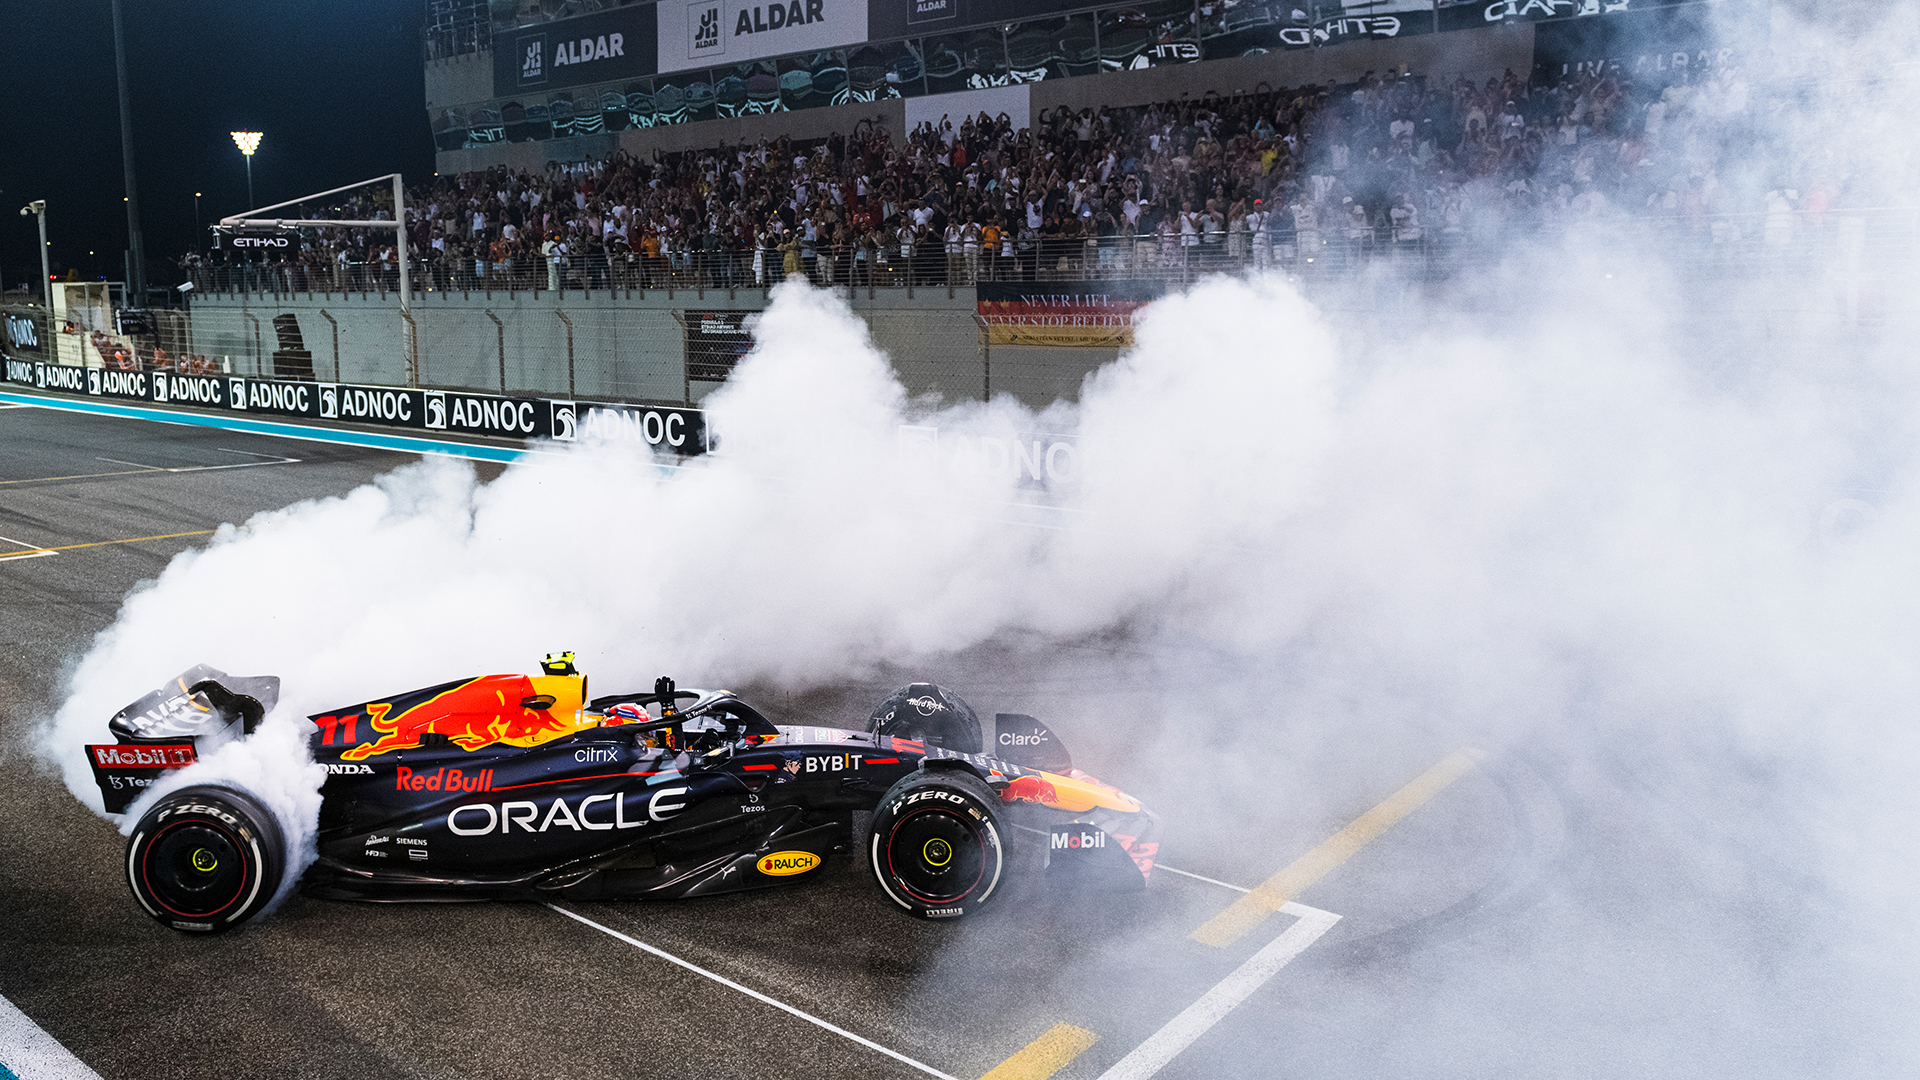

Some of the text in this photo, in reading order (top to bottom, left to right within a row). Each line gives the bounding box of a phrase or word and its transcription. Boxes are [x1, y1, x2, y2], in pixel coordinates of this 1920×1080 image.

[917, 0, 947, 13] ALDAR
[734, 0, 825, 36] ALDAR
[554, 32, 625, 67] ALDAR
[695, 38, 718, 49] ALDAR
[523, 69, 542, 78] ALDAR
[233, 238, 289, 248] ETIHAD
[1020, 294, 1071, 307] NEVER
[1030, 315, 1069, 328] STOP
[46, 365, 83, 391] ADNOC
[102, 373, 146, 396] ADNOC
[170, 377, 221, 403] ADNOC
[250, 385, 309, 412] ADNOC
[342, 389, 412, 421] ADNOC
[452, 398, 536, 433] ADNOC
[584, 407, 686, 446] ADNOC
[950, 434, 1078, 484] ADNO
[315, 714, 360, 746] 11
[999, 732, 1041, 746] Claro
[96, 748, 167, 765] Mobil
[574, 747, 618, 763] citrix
[805, 752, 862, 773] BYBIT
[320, 764, 376, 774] ONDA
[396, 766, 494, 792] Red Bull
[125, 777, 152, 787] Tez
[447, 787, 688, 836] ORACLE
[741, 805, 766, 813] Tezos
[892, 790, 966, 815] P ZERO
[158, 804, 238, 825] P ZERO
[396, 837, 428, 846] SIEMENS
[1051, 831, 1105, 849] Mobil
[774, 857, 813, 869] RAUCH
